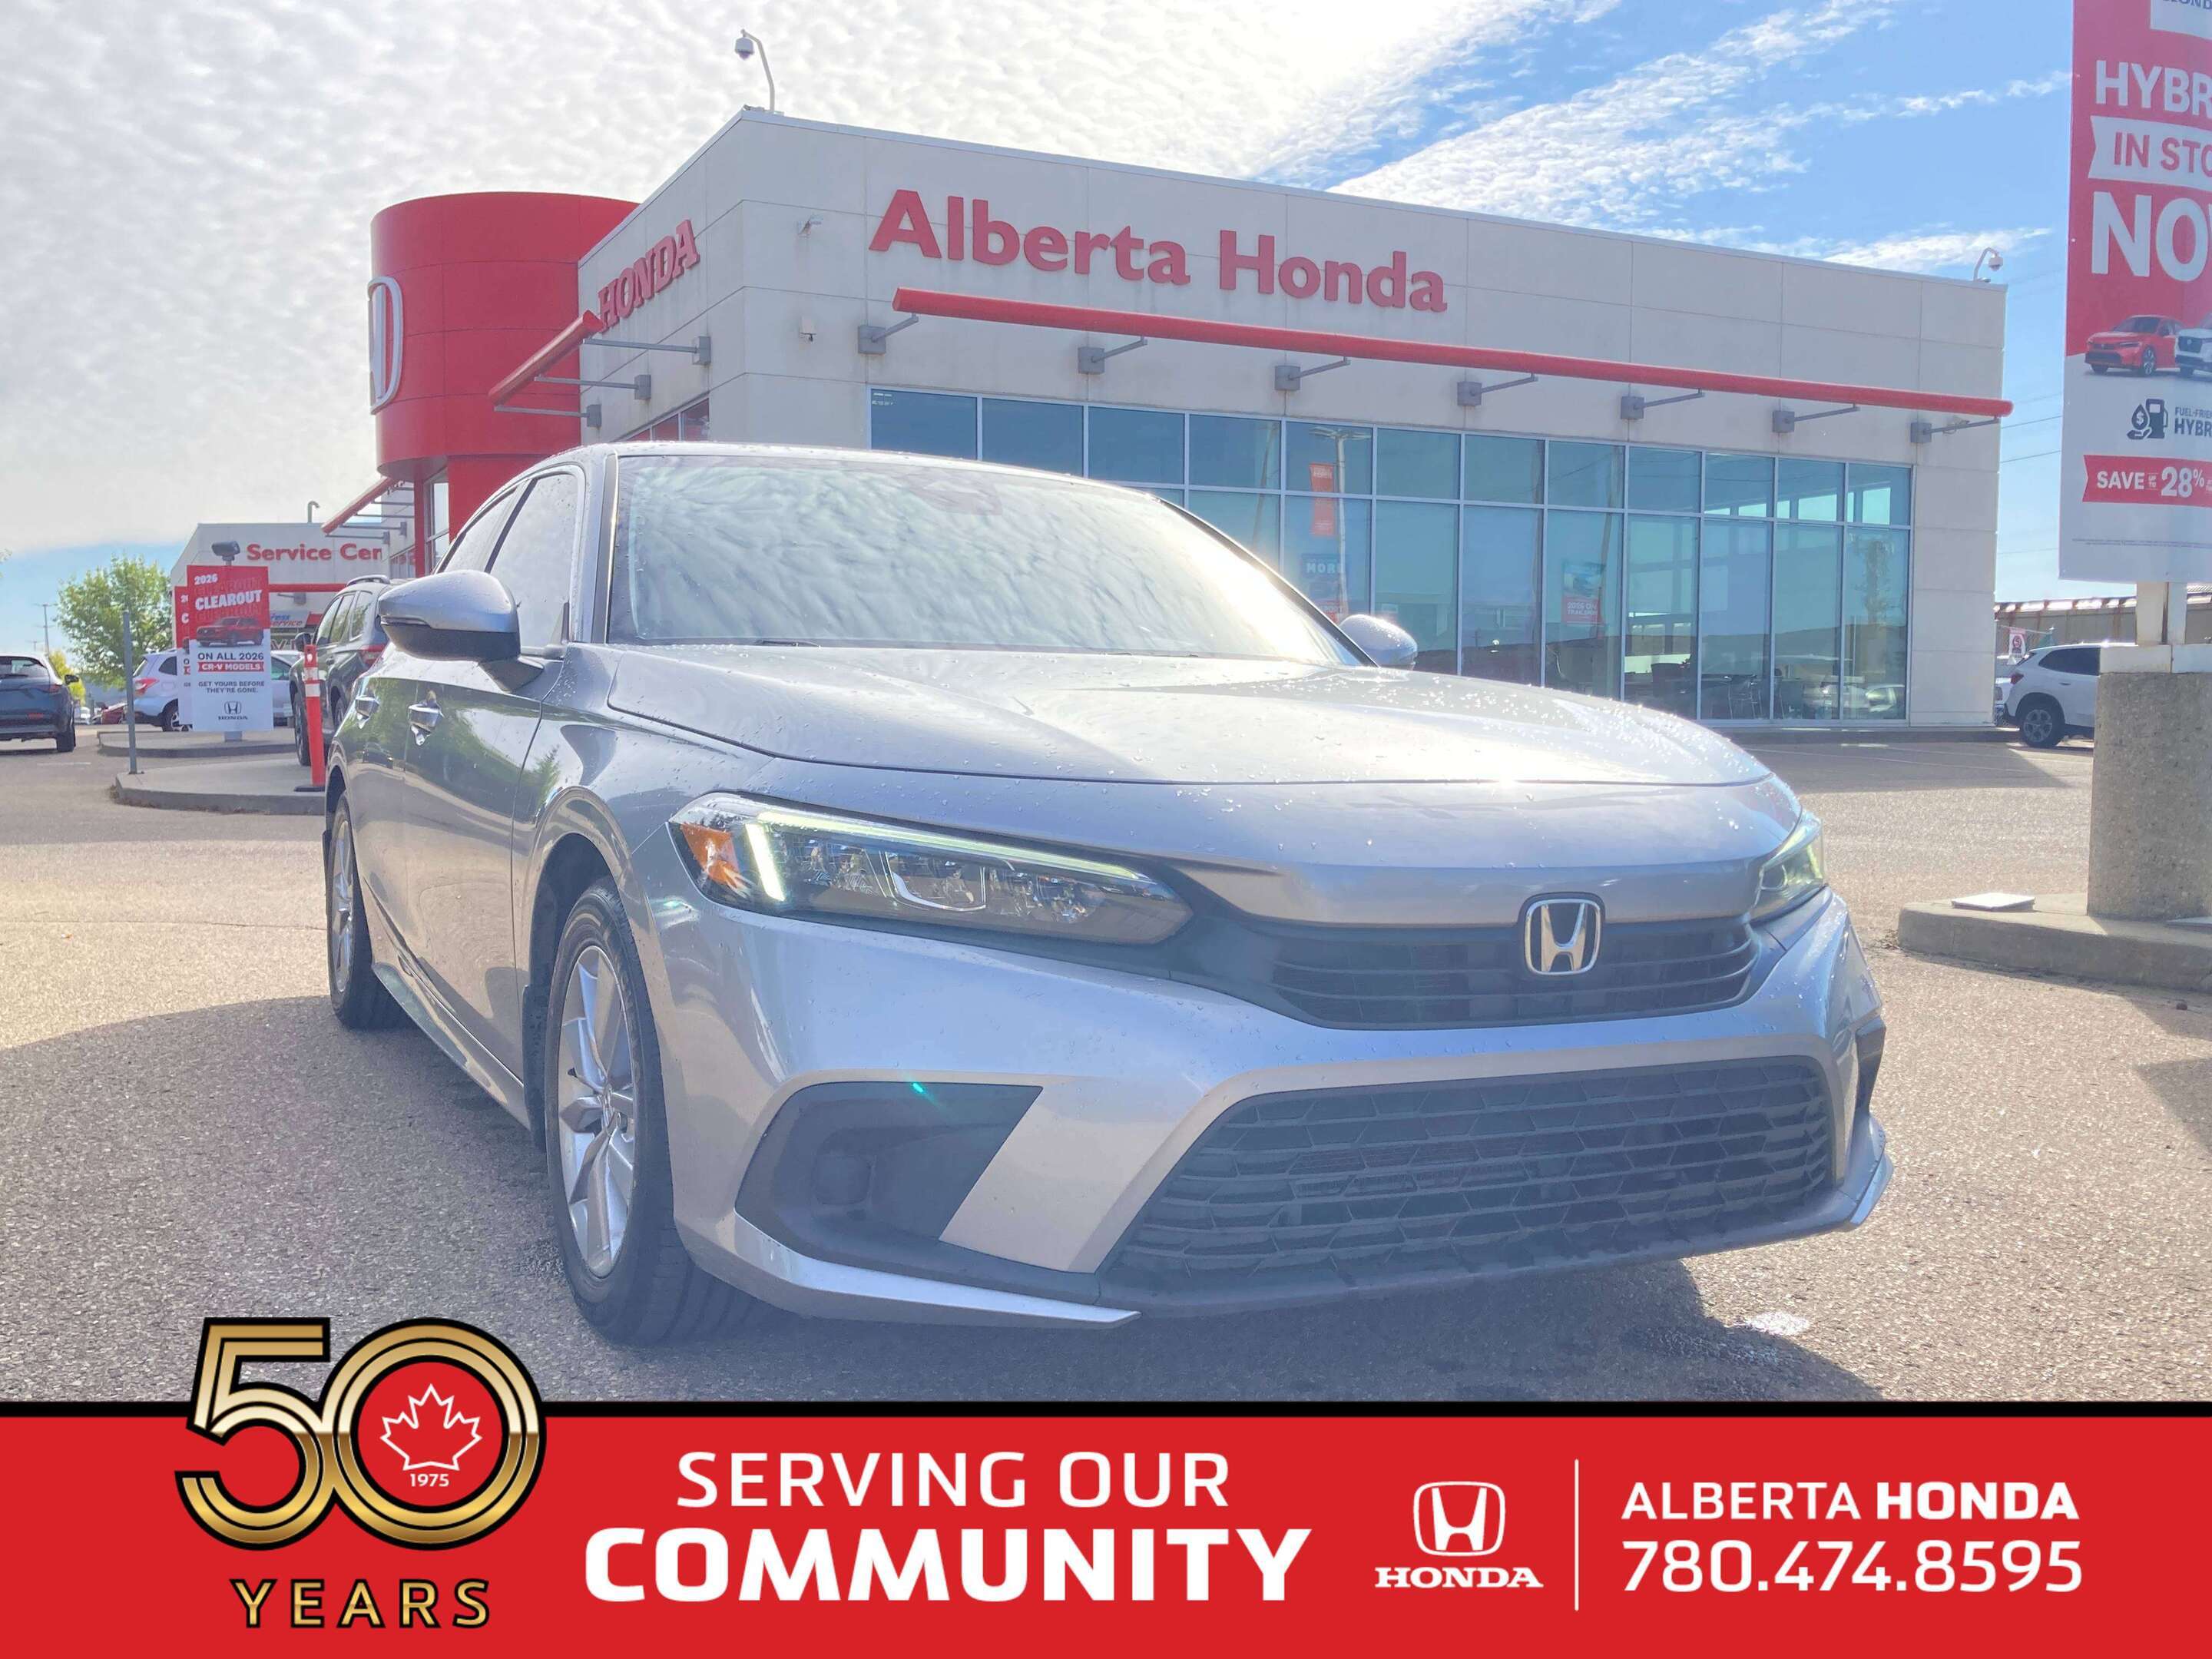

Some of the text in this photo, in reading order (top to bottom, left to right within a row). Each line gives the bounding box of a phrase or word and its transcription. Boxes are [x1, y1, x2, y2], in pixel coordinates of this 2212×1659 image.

[2114, 131, 2150, 167] IN
[869, 190, 1447, 313] Alberta Honda
[596, 220, 700, 333] HONDA
[2097, 471, 2145, 489] SAVE
[247, 543, 332, 561] Service
[194, 573, 219, 585] 2026
[195, 589, 262, 611] CLEAROUT
[197, 652, 264, 661] ON ALL 2026
